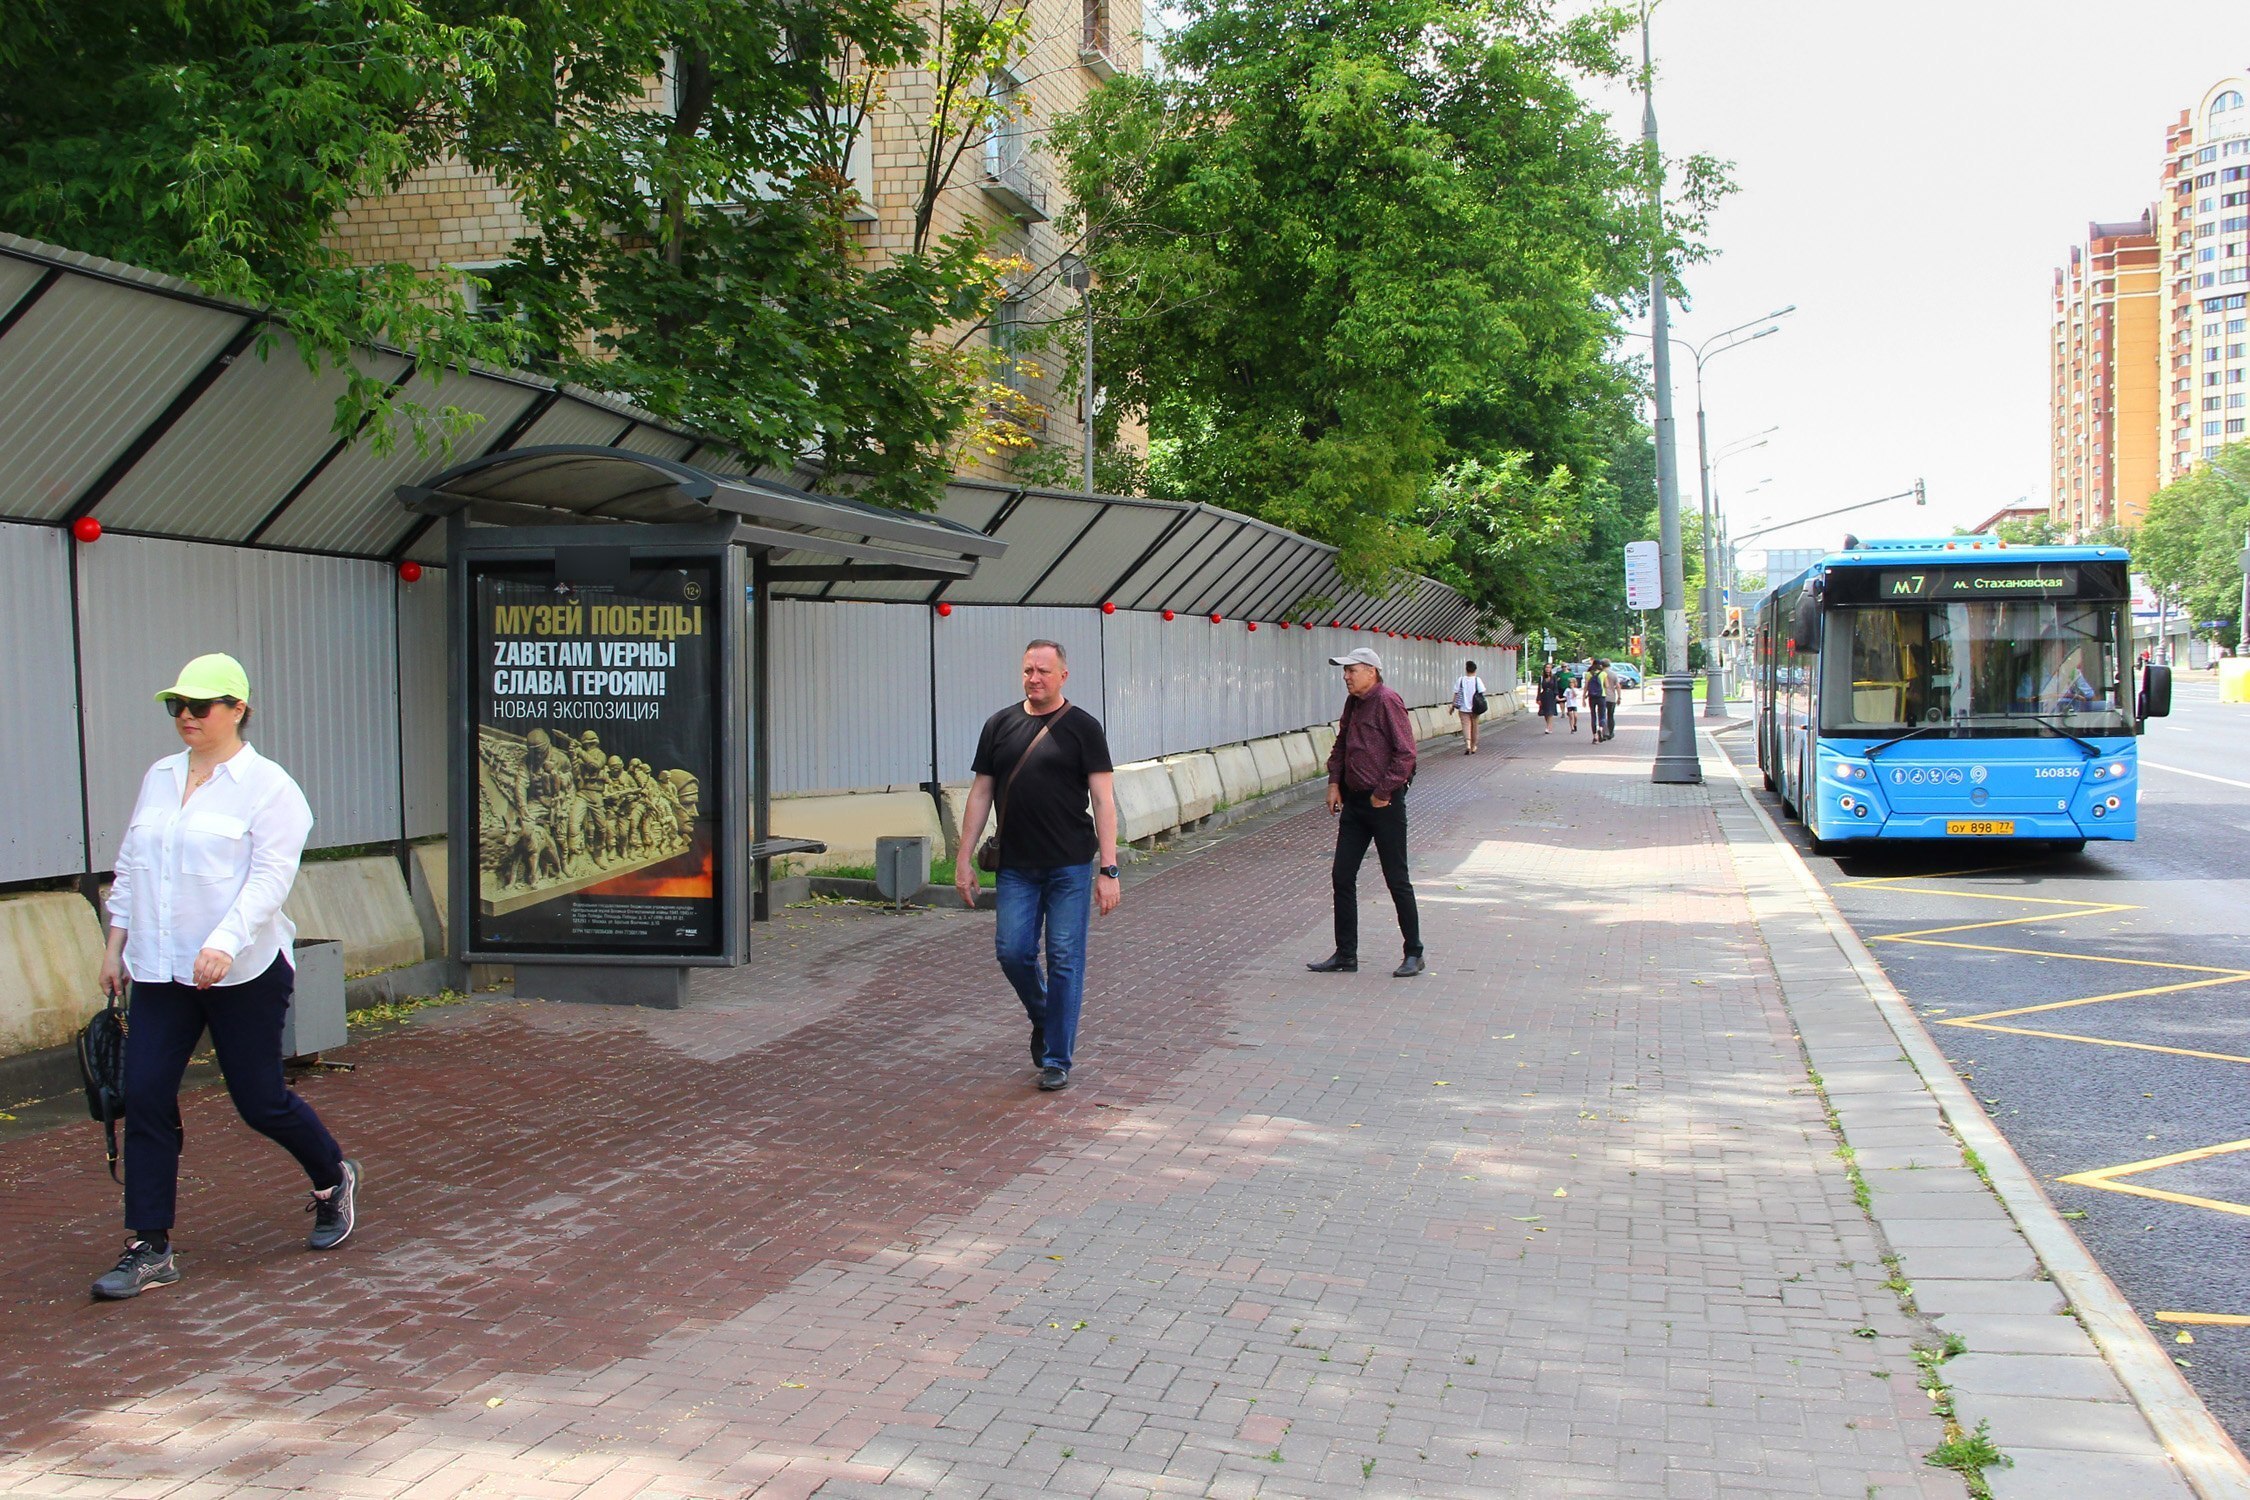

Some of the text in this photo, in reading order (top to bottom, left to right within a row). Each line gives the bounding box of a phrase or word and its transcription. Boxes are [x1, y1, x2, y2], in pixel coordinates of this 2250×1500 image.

[1974, 578, 2063, 589] Стахановская
[495, 599, 702, 640] МУЗЕЙ ПОБЕДЫ
[494, 670, 666, 696] СЛАВА ГЕРОЯМ!
[494, 700, 659, 721] НОВАЯ ЭКСПОЗИЦИЯ
[2035, 767, 2080, 778] 160836
[2057, 800, 2066, 810] 8
[1971, 823, 1992, 833] 898
[1999, 822, 2010, 830] 77
